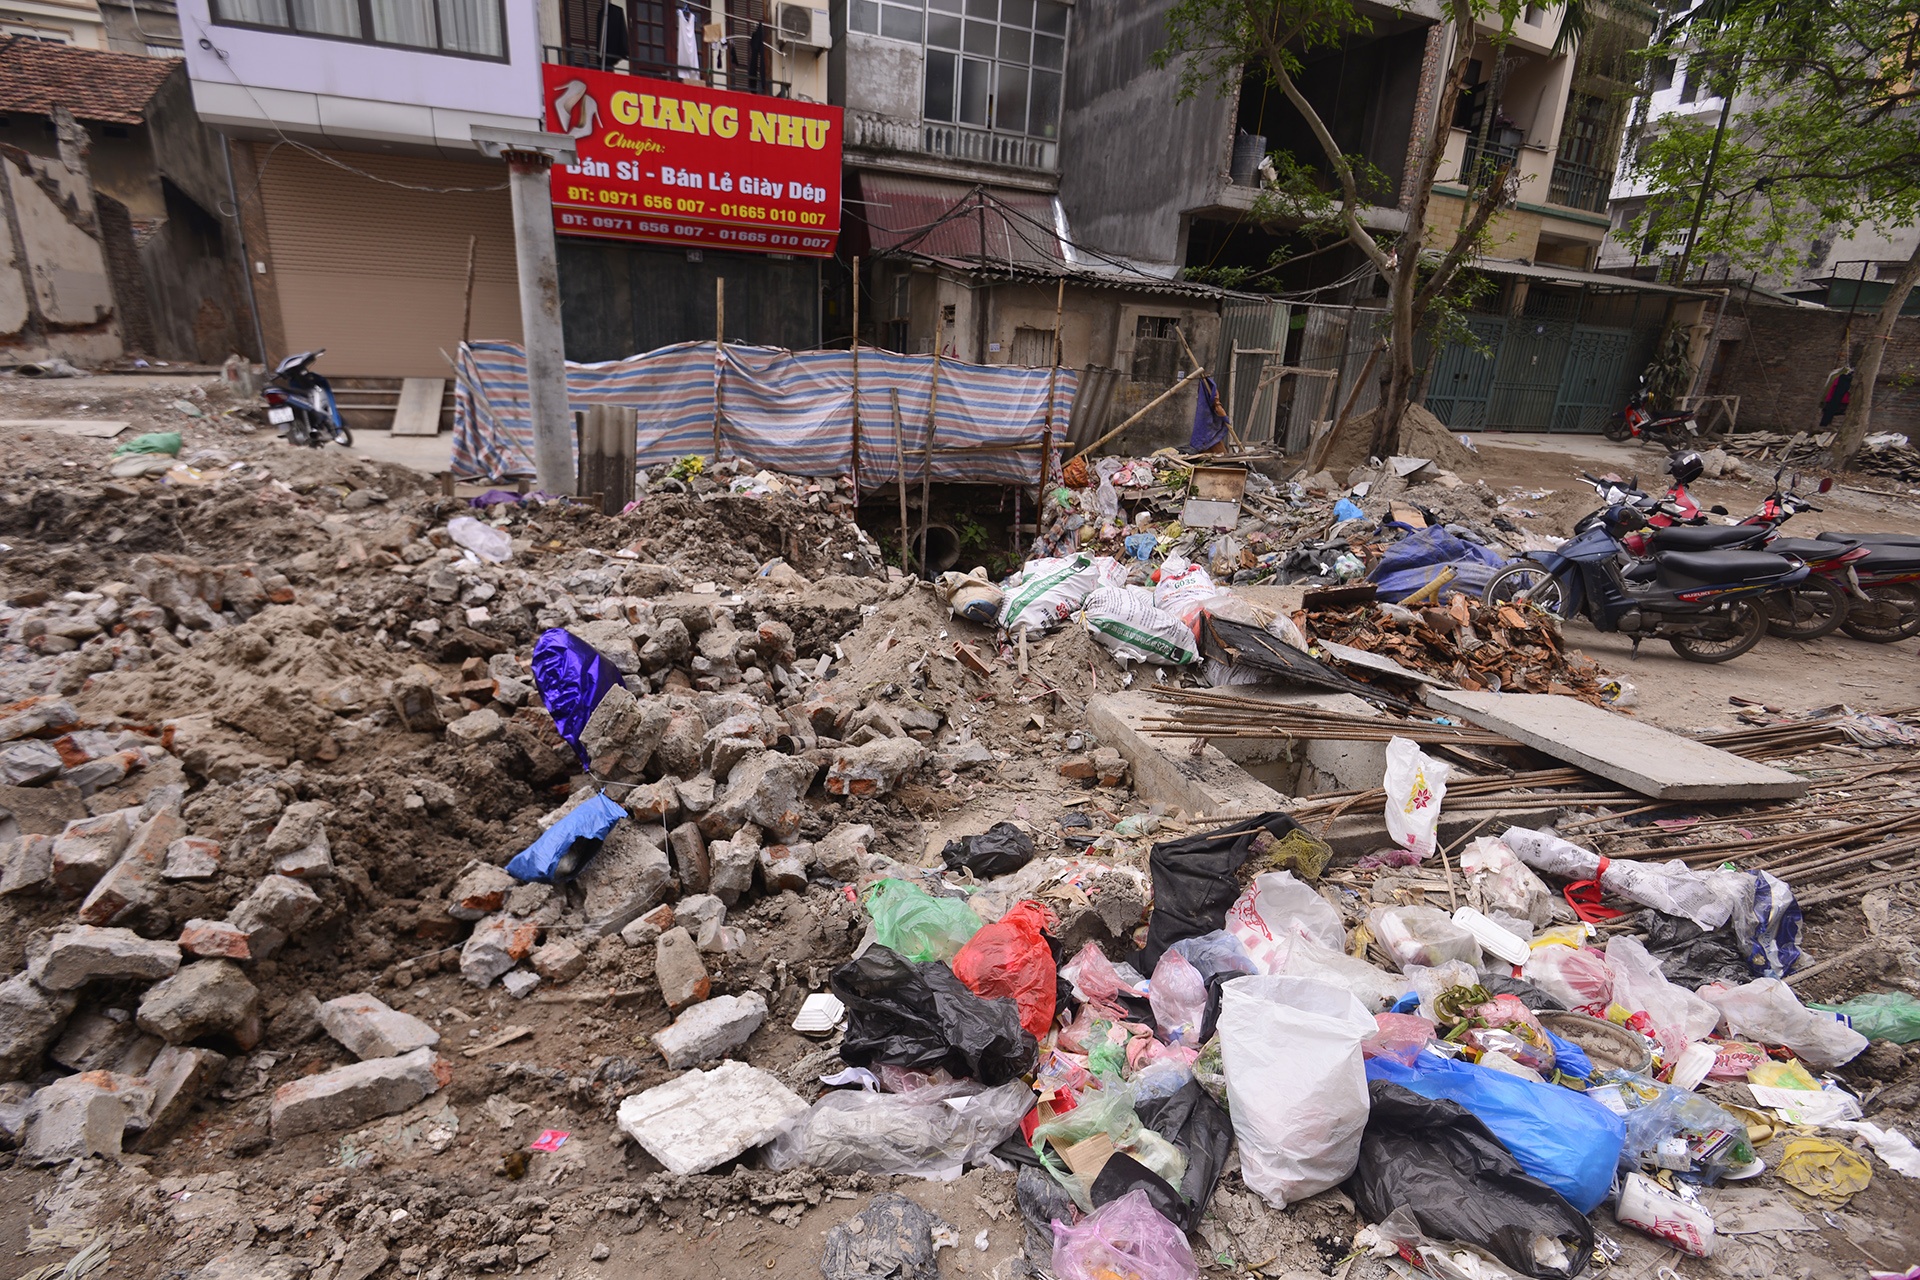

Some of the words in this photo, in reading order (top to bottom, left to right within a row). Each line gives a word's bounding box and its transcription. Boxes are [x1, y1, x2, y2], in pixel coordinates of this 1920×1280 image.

[610, 91, 739, 139] GIANG
[749, 110, 831, 151] NHƯ
[604, 130, 666, 156] Chuyên:
[616, 160, 640, 182] Sỉ
[661, 165, 703, 189] Bán
[708, 171, 733, 192] Lẻ
[739, 176, 783, 199] Giày
[789, 181, 827, 204] Dép
[567, 186, 595, 202] ĐT:
[599, 190, 638, 206] 0971
[643, 194, 673, 210] 656
[677, 198, 705, 213] 007
[720, 203, 766, 220] 01665
[770, 208, 797, 223] 010
[800, 211, 826, 226] 007
[592, 216, 633, 230] 0971
[639, 221, 670, 234] 656
[674, 224, 704, 237] 007
[719, 229, 767, 243] 01665
[770, 234, 799, 246] 010
[802, 237, 830, 249] 007
